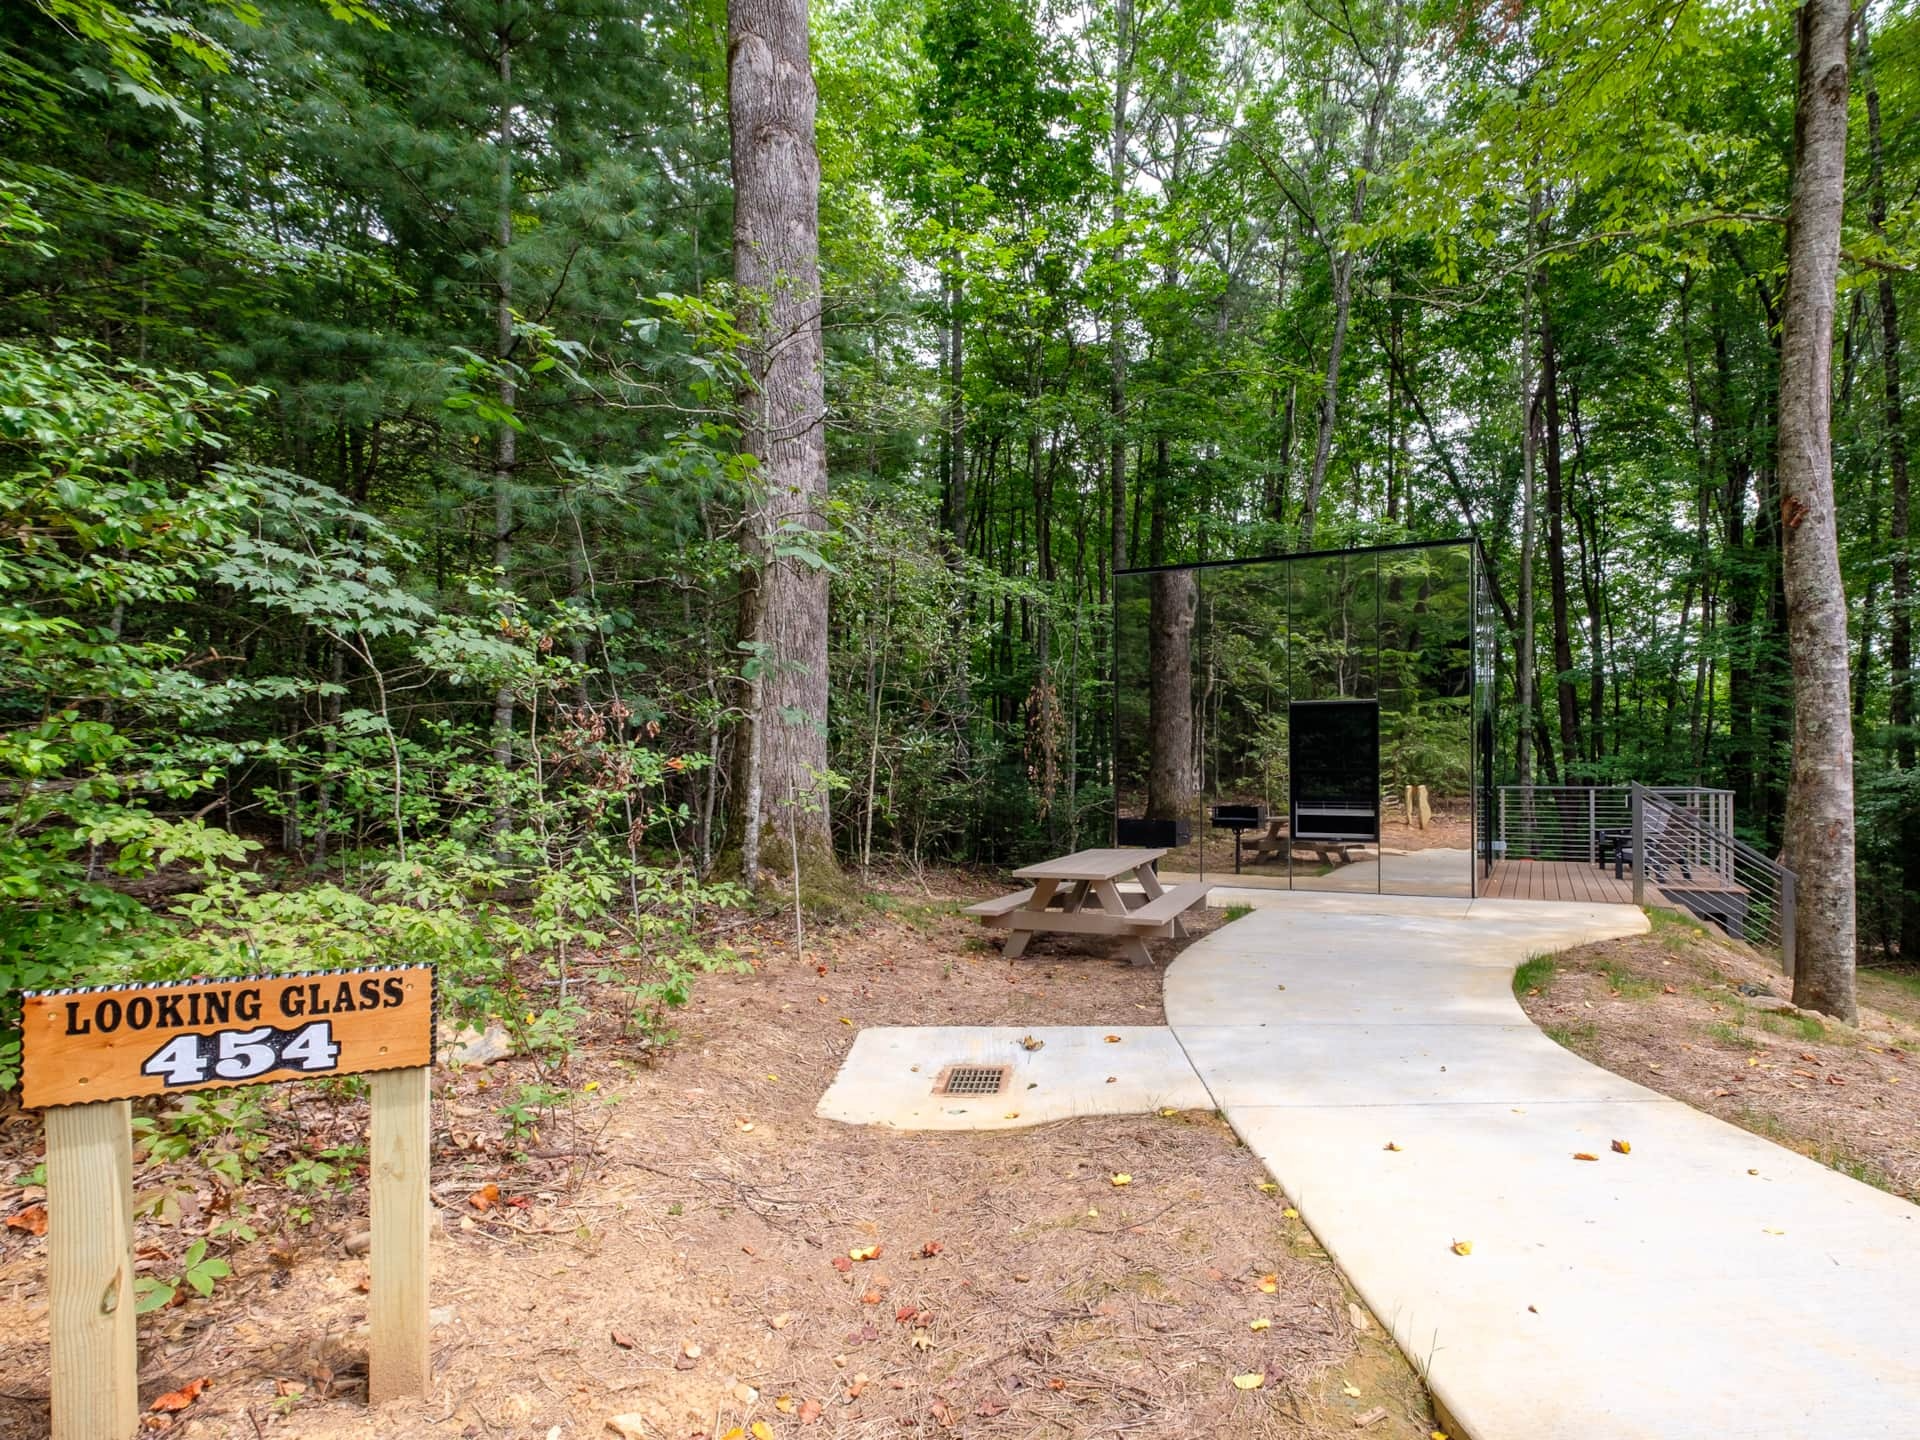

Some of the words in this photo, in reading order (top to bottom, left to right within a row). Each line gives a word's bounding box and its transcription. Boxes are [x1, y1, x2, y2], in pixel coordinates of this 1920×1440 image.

[65, 988, 262, 1035] LOOKING
[280, 977, 404, 1016] GLASS
[143, 1021, 340, 1086] 454
